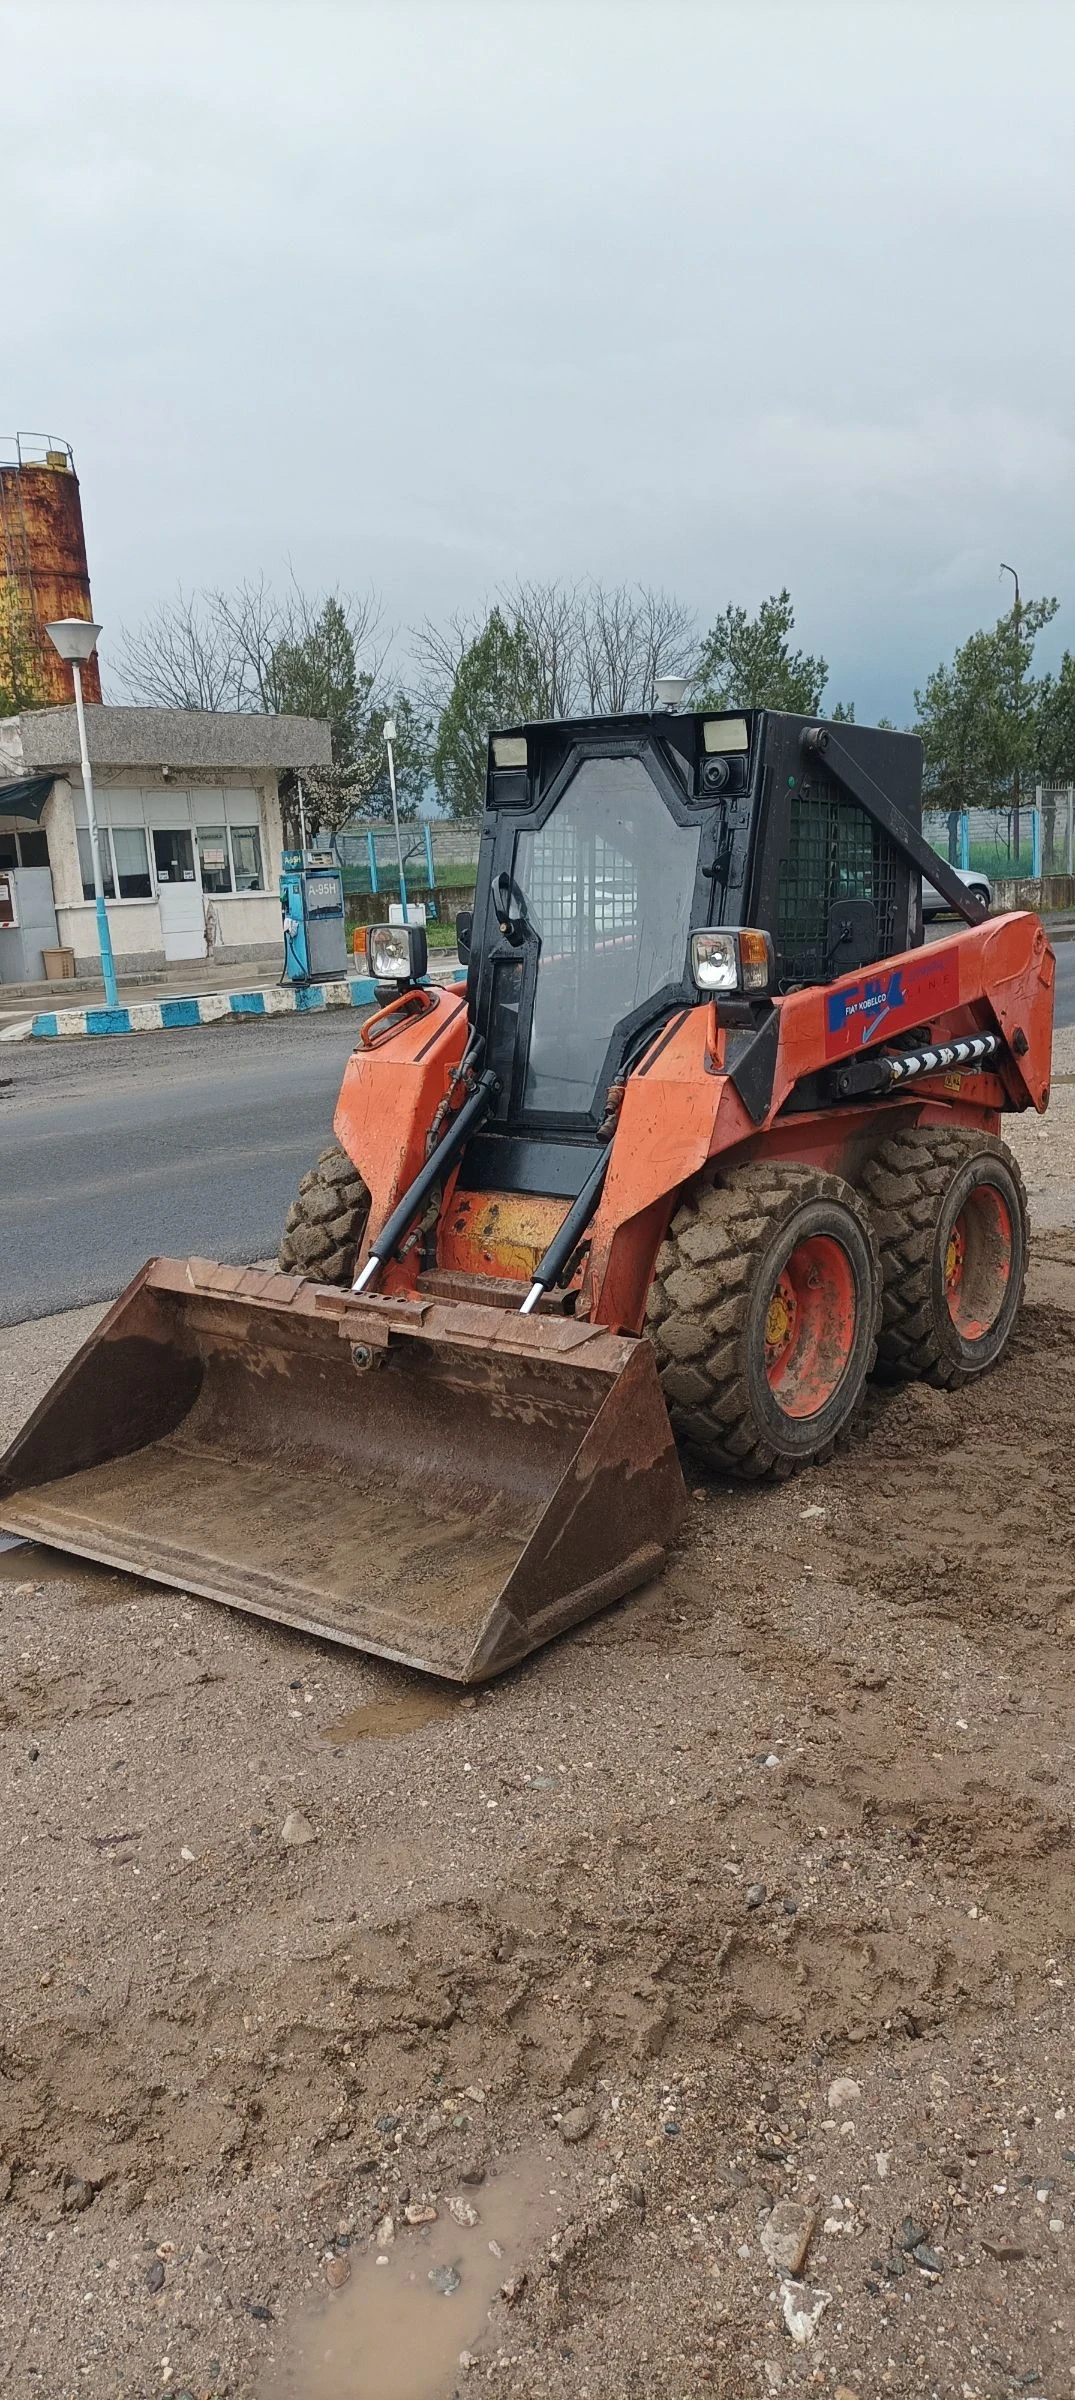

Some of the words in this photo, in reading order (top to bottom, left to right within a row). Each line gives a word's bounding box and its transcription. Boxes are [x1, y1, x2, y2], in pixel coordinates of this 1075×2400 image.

[308, 882, 337, 896] A-95H
[845, 1004, 858, 1016] FIAT
[858, 993, 887, 1010] KOBELCO
